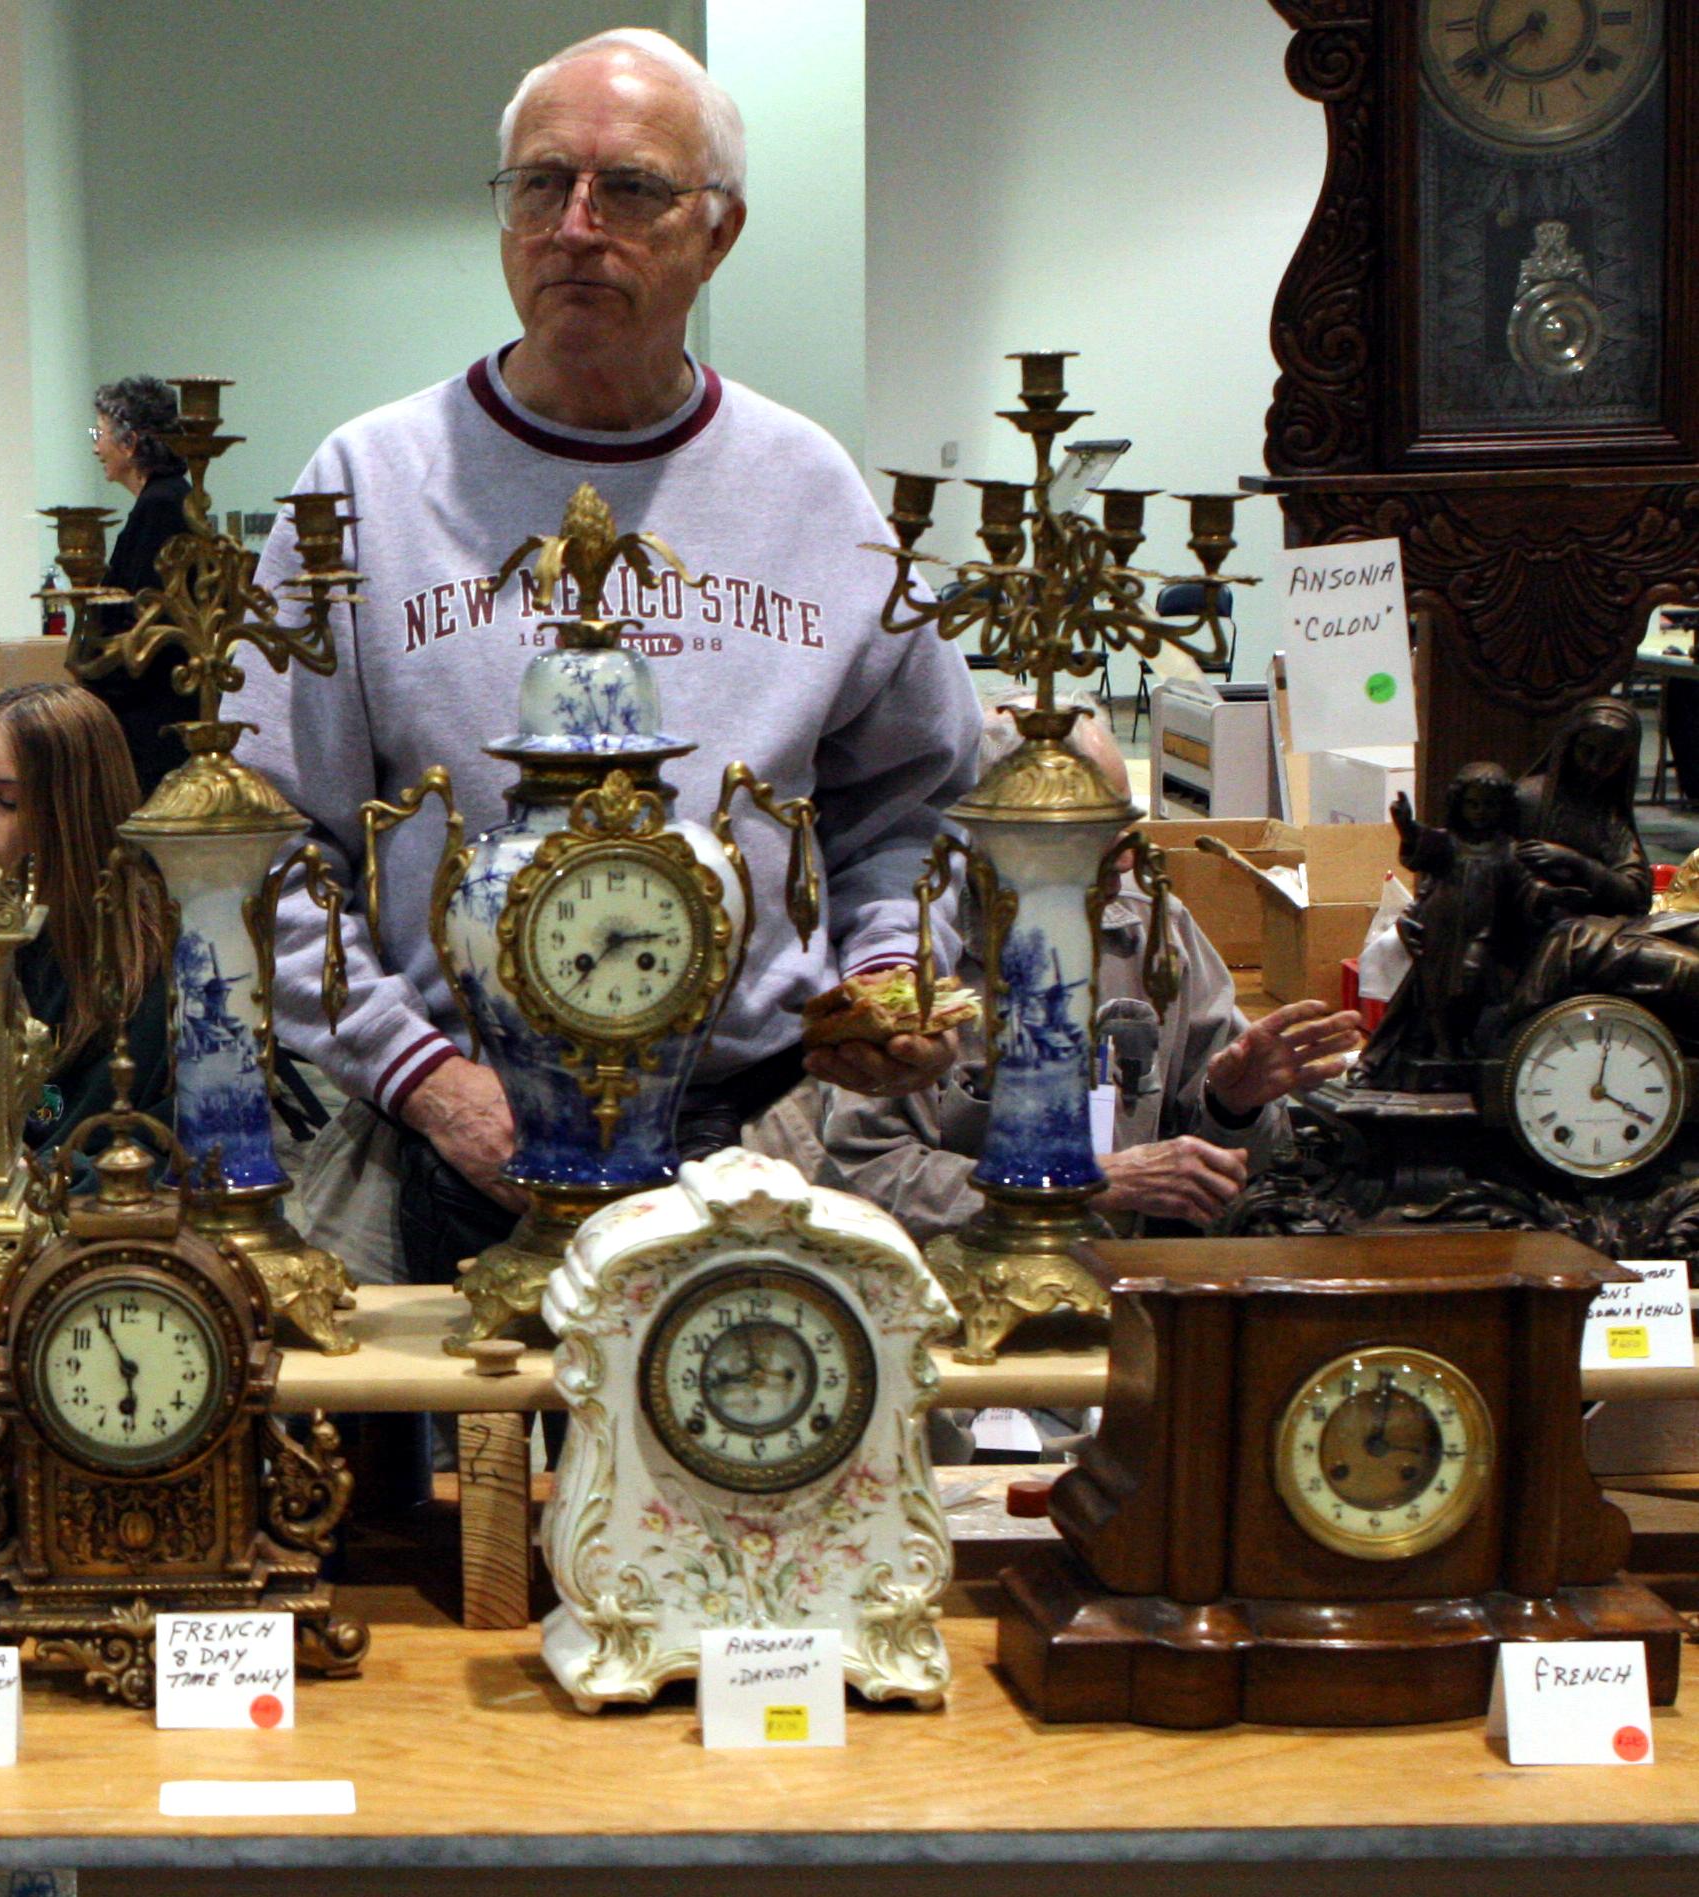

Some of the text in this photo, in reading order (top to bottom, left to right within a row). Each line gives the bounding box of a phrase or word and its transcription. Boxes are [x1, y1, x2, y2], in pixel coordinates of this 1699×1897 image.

[1289, 561, 1396, 597] ANSONIA
[403, 572, 500, 653] NEW
[701, 572, 827, 651] STATE
[620, 637, 672, 653] RSITY
[1599, 1285, 1632, 1300] ONS
[168, 1621, 276, 1646] FRENCH
[725, 1636, 814, 1656] ANSONIA
[173, 1647, 248, 1671] 8 DAY
[166, 1668, 290, 1691] TIME ONLY
